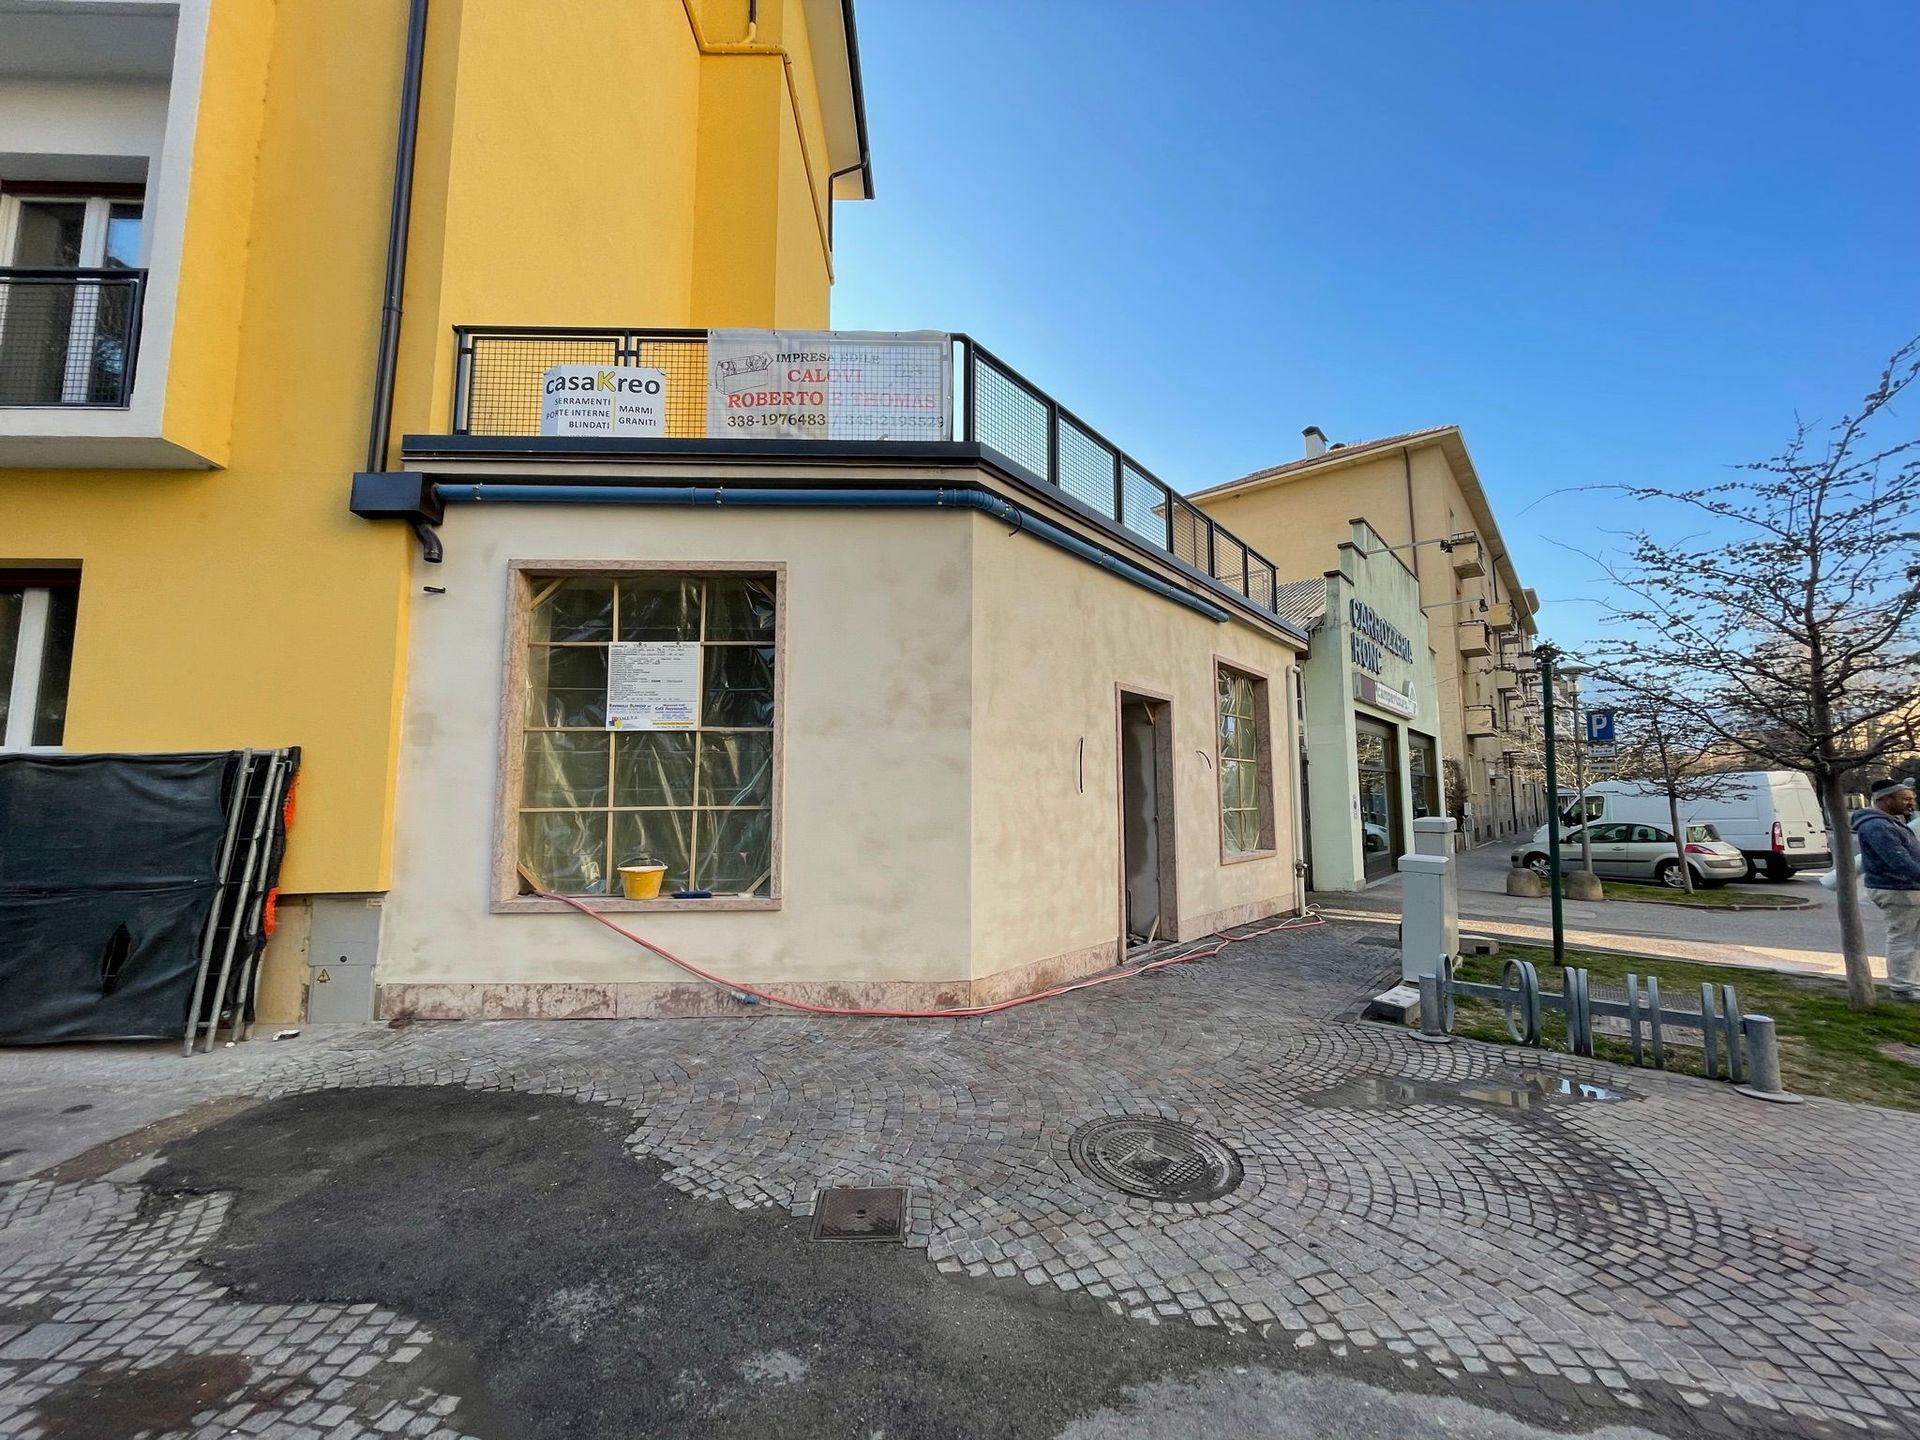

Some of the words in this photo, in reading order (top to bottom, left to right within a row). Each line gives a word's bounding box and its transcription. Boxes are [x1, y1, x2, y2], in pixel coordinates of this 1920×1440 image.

[776, 352, 834, 364] IMPRESA
[546, 371, 661, 395] casaKreo
[554, 397, 611, 406] SERRAMENTI
[727, 391, 824, 409] ROBERTO
[546, 409, 569, 420] PORTE
[571, 408, 610, 418] INTERNE
[618, 405, 653, 415] MARMI
[568, 420, 610, 429] BLINDATI
[618, 416, 656, 427] GRANITI
[727, 413, 826, 428] 338-1976483
[1349, 598, 1413, 664] CARROZZERIA
[1591, 714, 1607, 738] P
